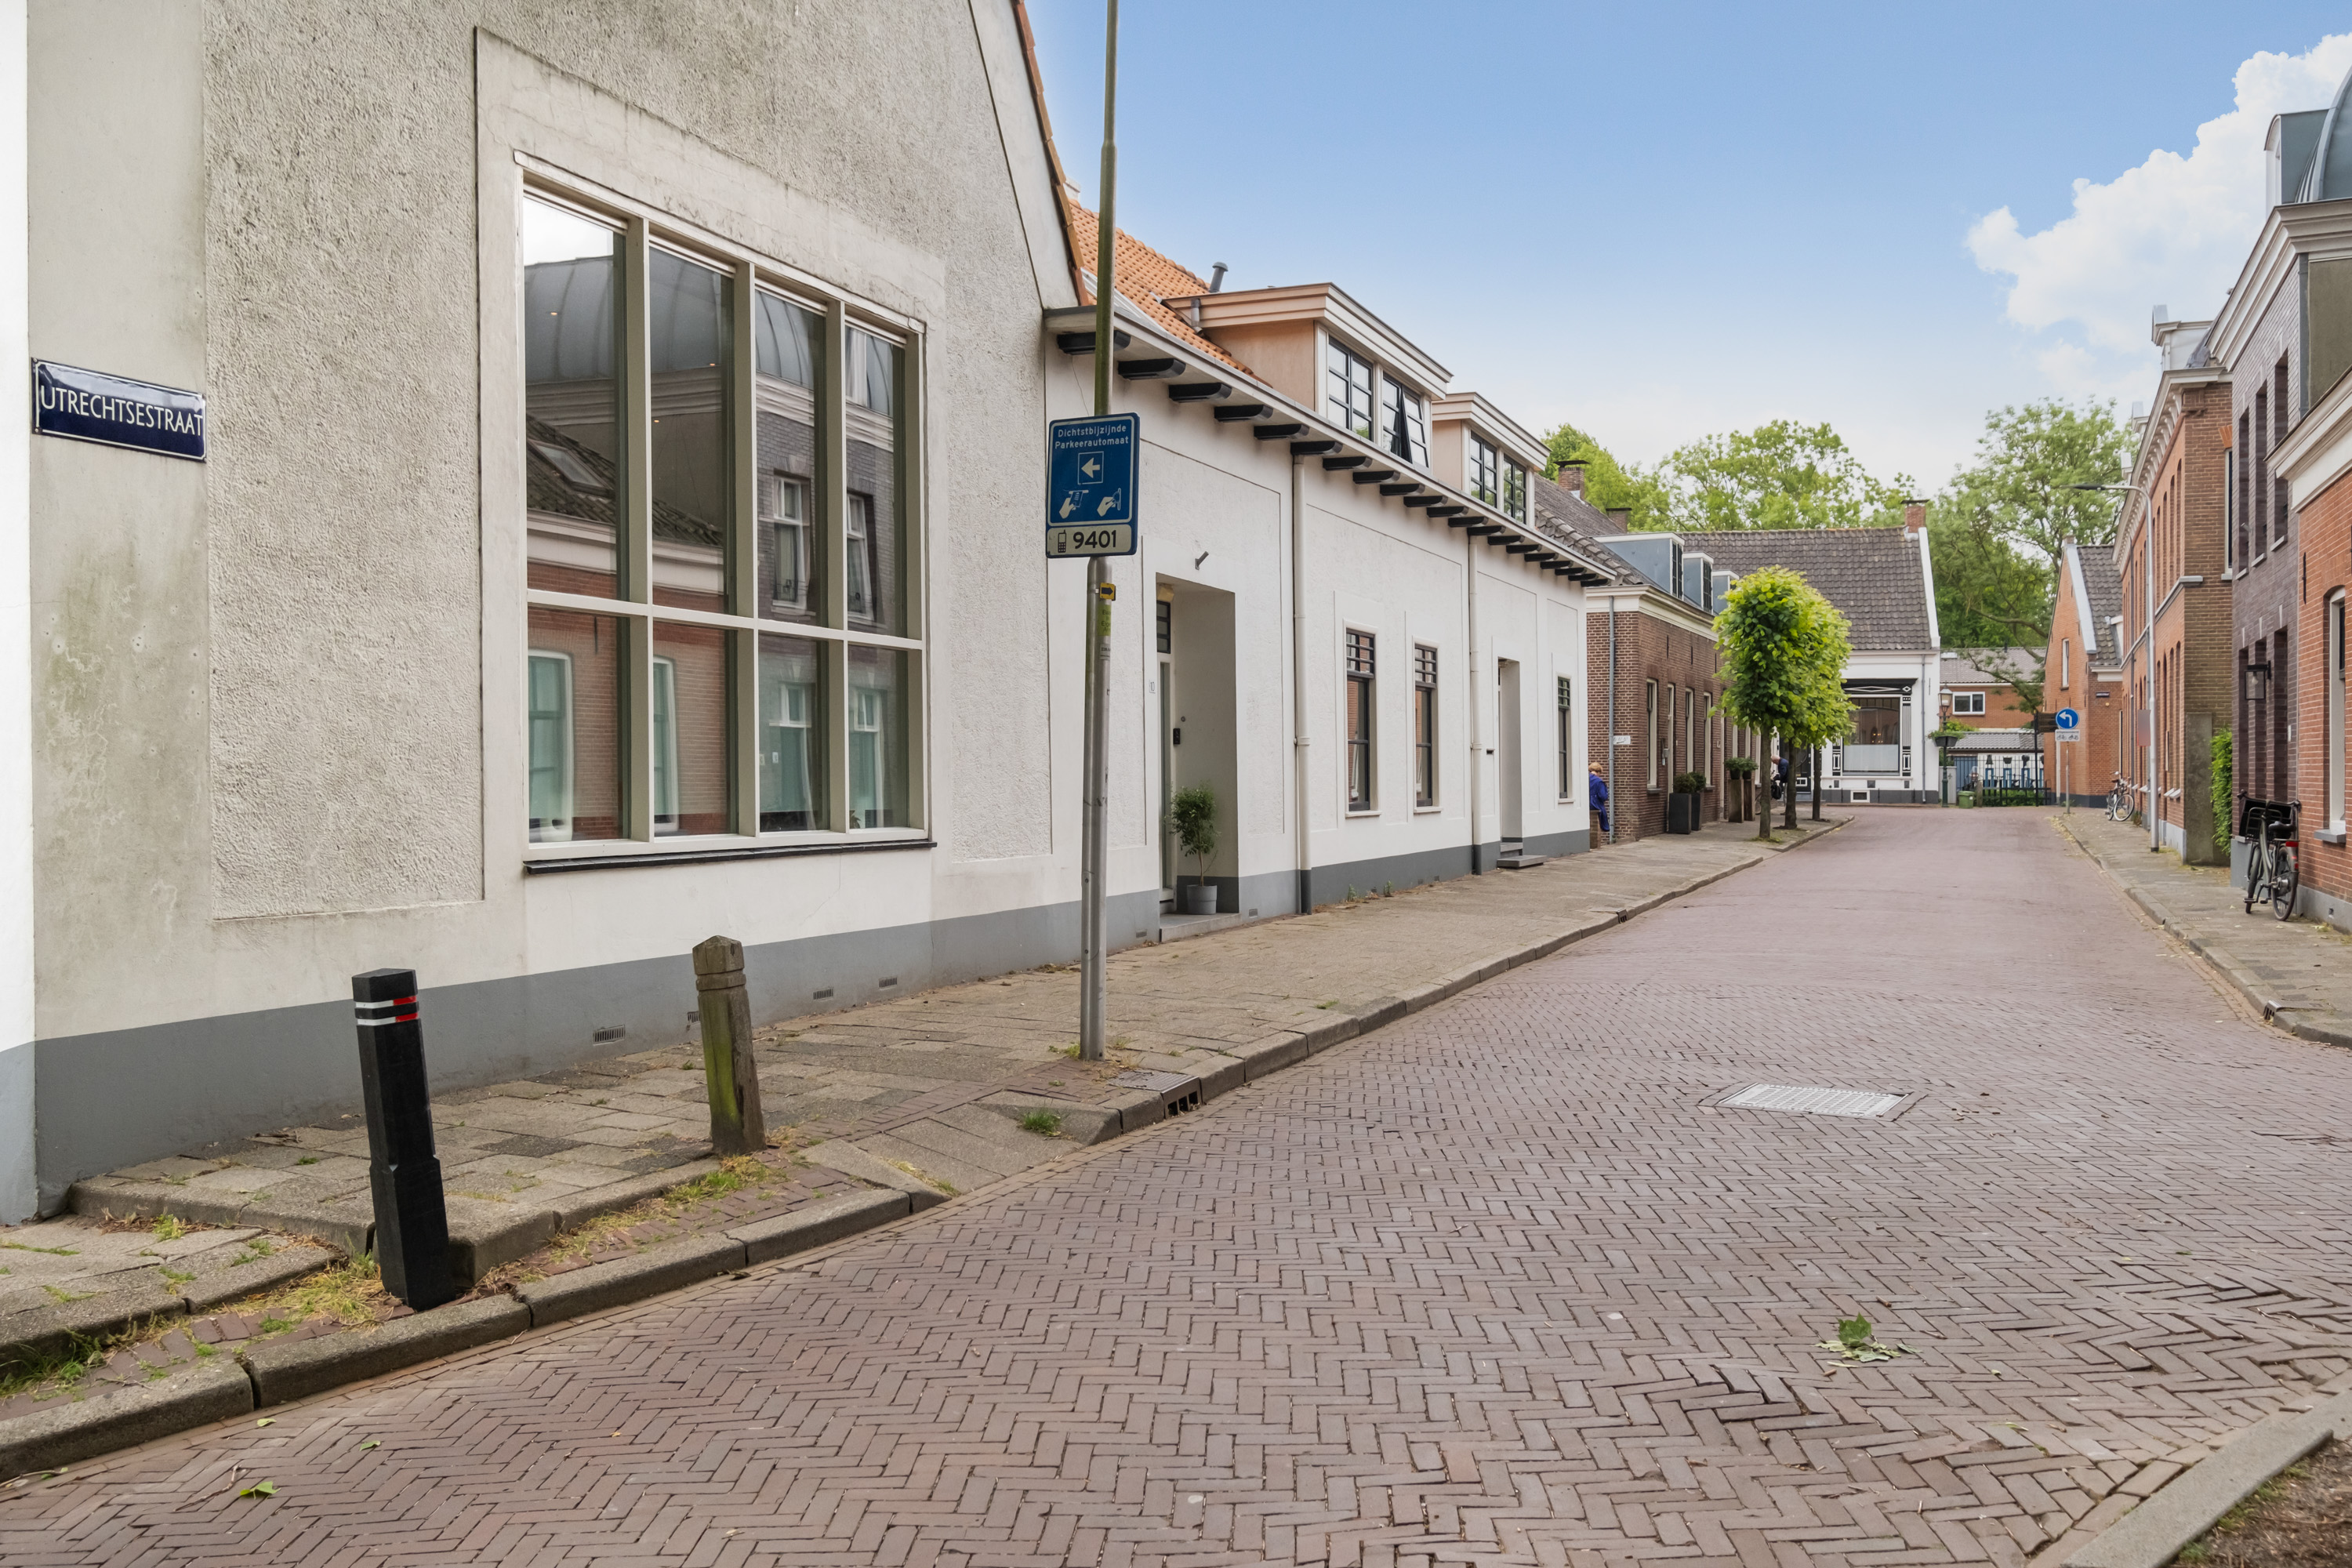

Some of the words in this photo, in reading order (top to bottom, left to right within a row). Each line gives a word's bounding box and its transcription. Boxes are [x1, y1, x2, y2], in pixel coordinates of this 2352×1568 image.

[41, 385, 204, 437] UTRECHTSESTRAAT
[1058, 424, 1127, 437] Dichtstbijzijnde
[1054, 436, 1129, 449] Parkeerautomaat
[1073, 529, 1116, 549] 9401
